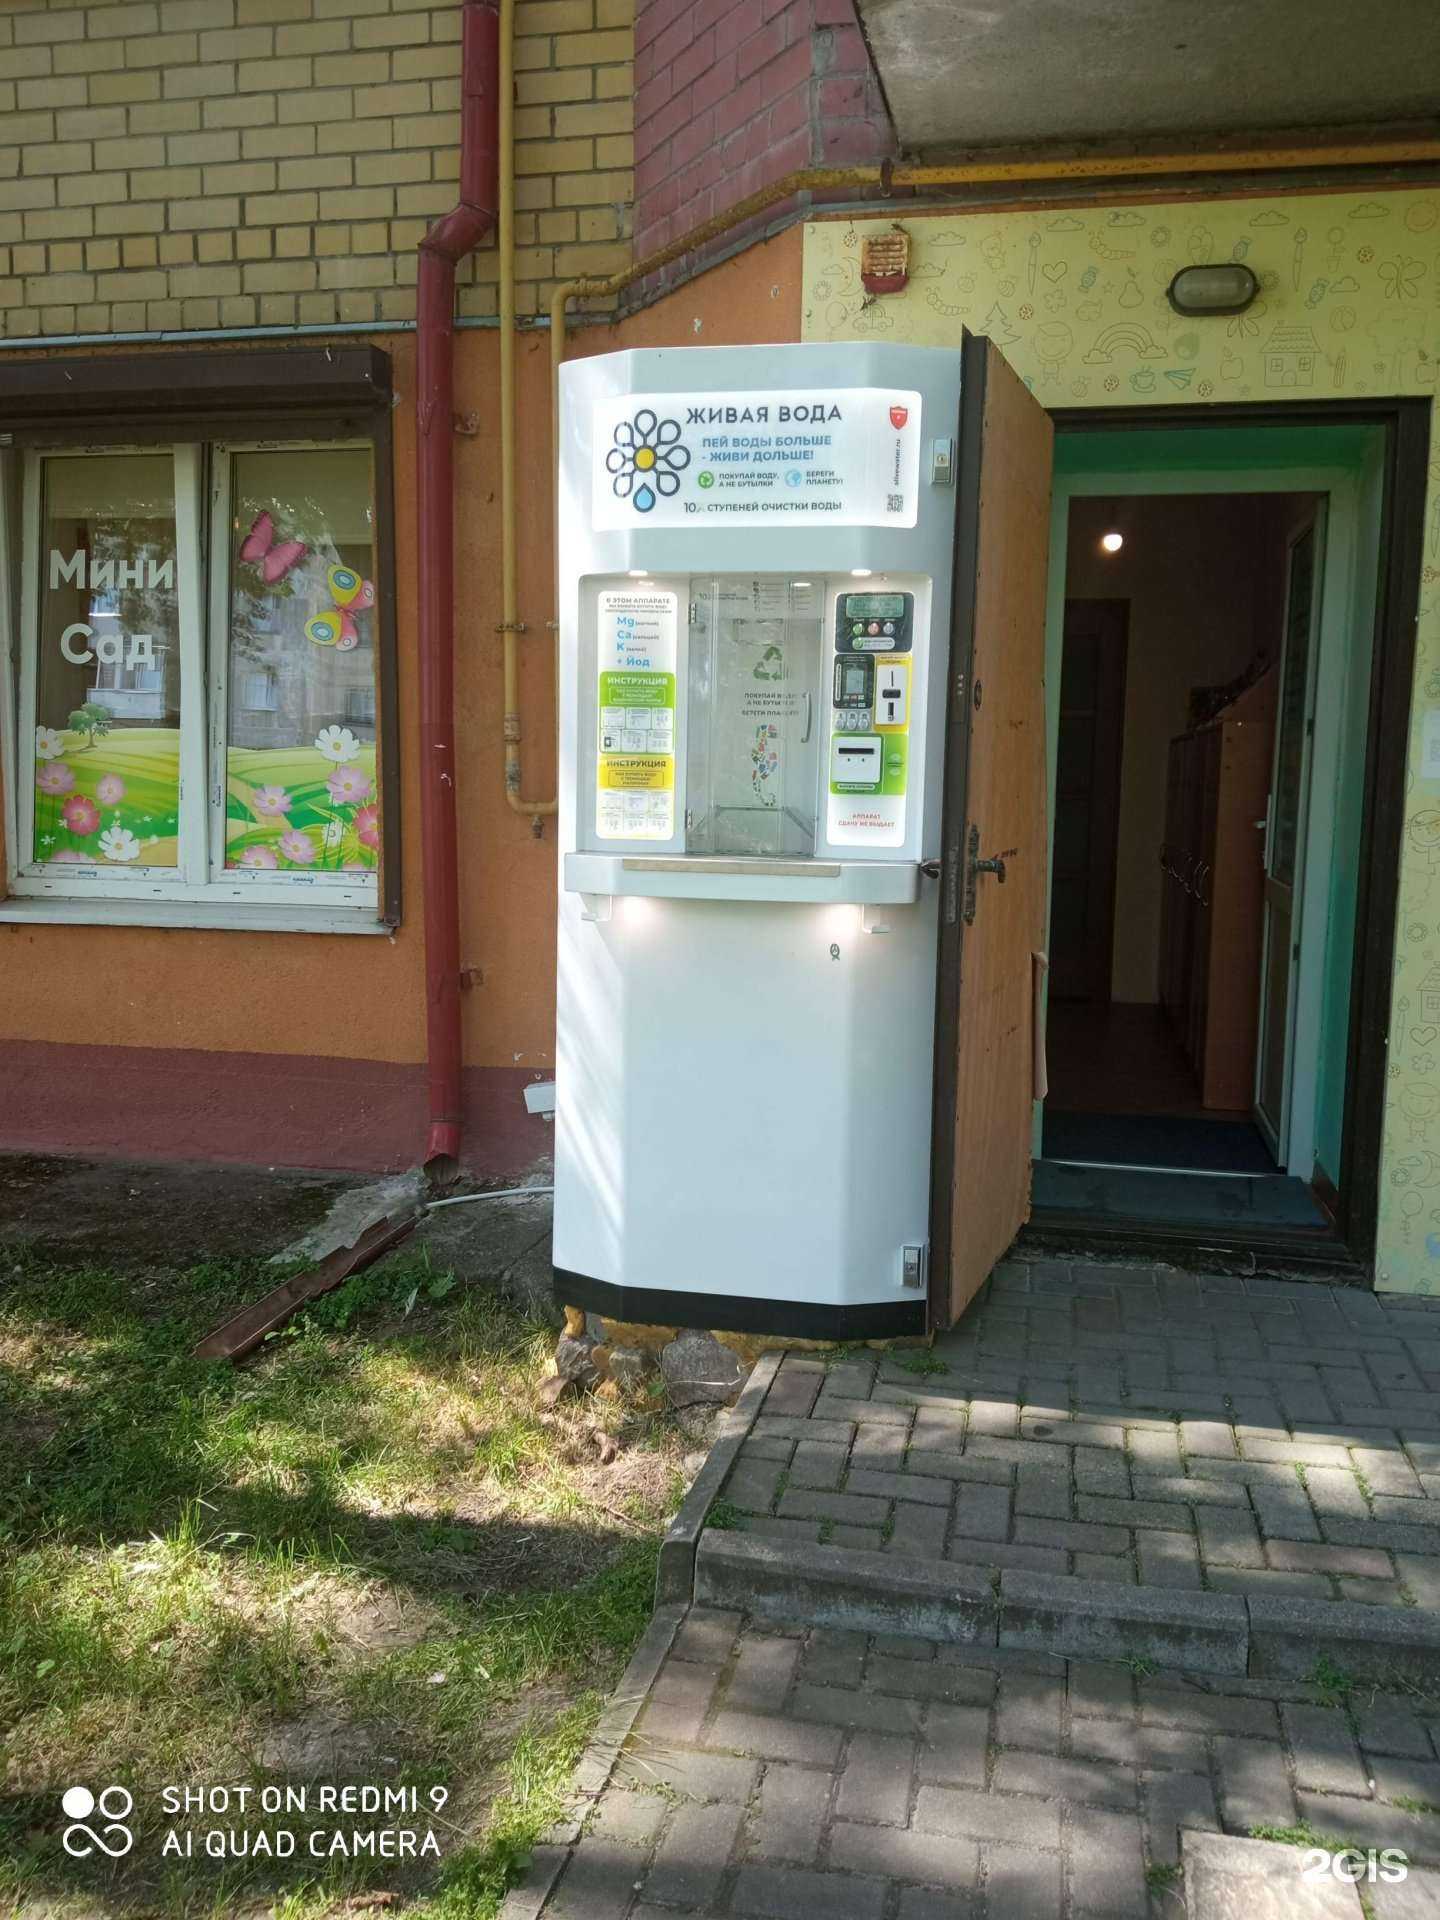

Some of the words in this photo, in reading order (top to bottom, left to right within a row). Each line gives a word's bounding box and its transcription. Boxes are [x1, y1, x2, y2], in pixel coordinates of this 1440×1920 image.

[686, 407, 769, 425] ЖИВАЯ
[779, 405, 843, 424] ВОДА
[702, 436, 729, 448] ПЕЙ
[732, 437, 772, 449] ВОДЫ
[775, 435, 832, 447] БОЛЬШЕ
[710, 451, 750, 462] ЖИВИ
[752, 450, 814, 462] ДОЛЬШЕ!
[719, 472, 756, 480] ПОКУПАЙ
[806, 470, 835, 478] БЕРЕГИ
[707, 501, 759, 512] СТУПЕНЕЙ
[761, 502, 809, 512] ОЧИСТКИ
[811, 502, 842, 511] ВОДЫ
[49, 548, 173, 590] Мини
[617, 617, 635, 627] Mg
[617, 630, 632, 639] Ca
[60, 623, 156, 671] Сад
[606, 760, 667, 768] ИНСТРУКЦИЯ
